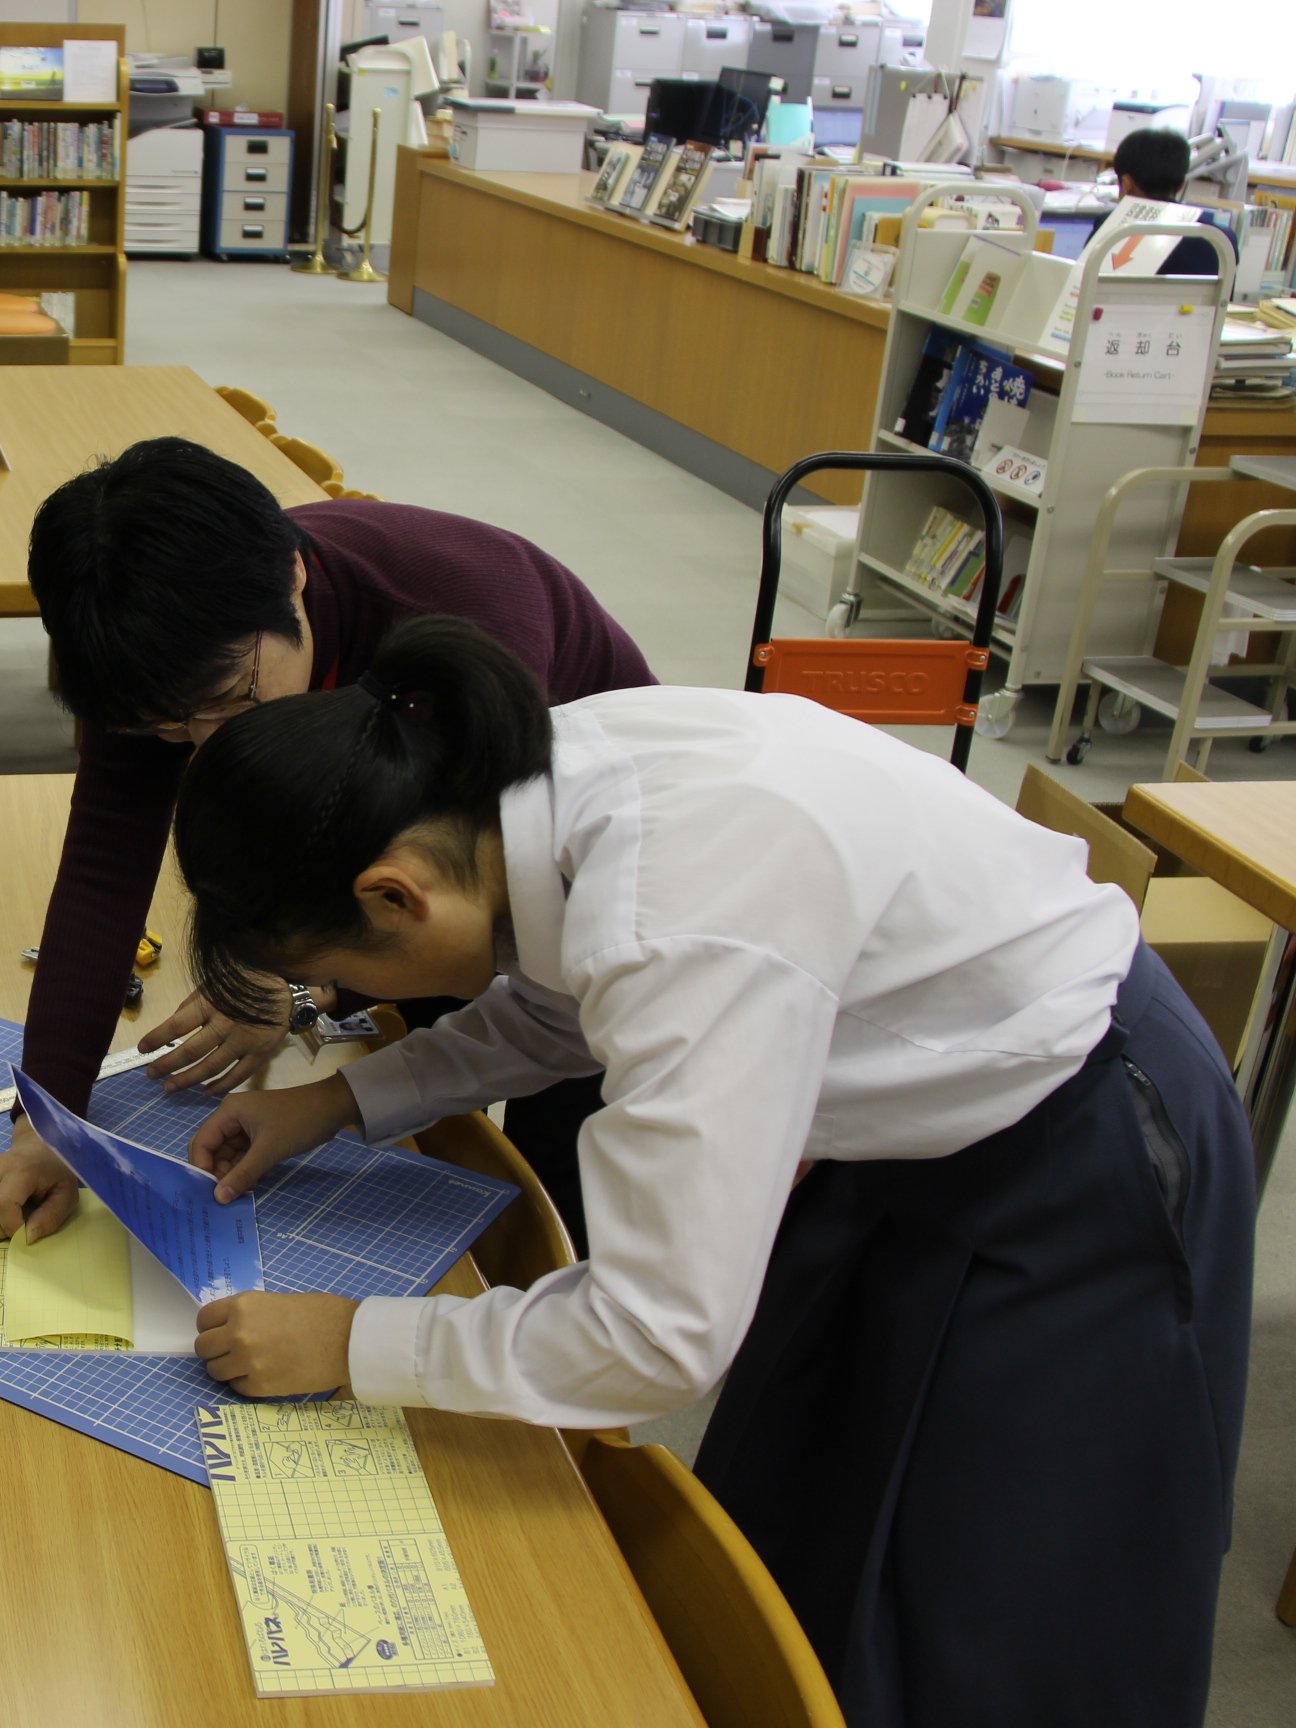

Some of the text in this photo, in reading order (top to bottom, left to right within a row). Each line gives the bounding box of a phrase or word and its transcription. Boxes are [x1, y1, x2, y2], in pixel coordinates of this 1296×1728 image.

[1105, 340, 1181, 356] 返却台
[1127, 371, 1152, 379] Return
[802, 670, 928, 695] TRUSCO
[262, 1616, 291, 1666] ハレパネ
